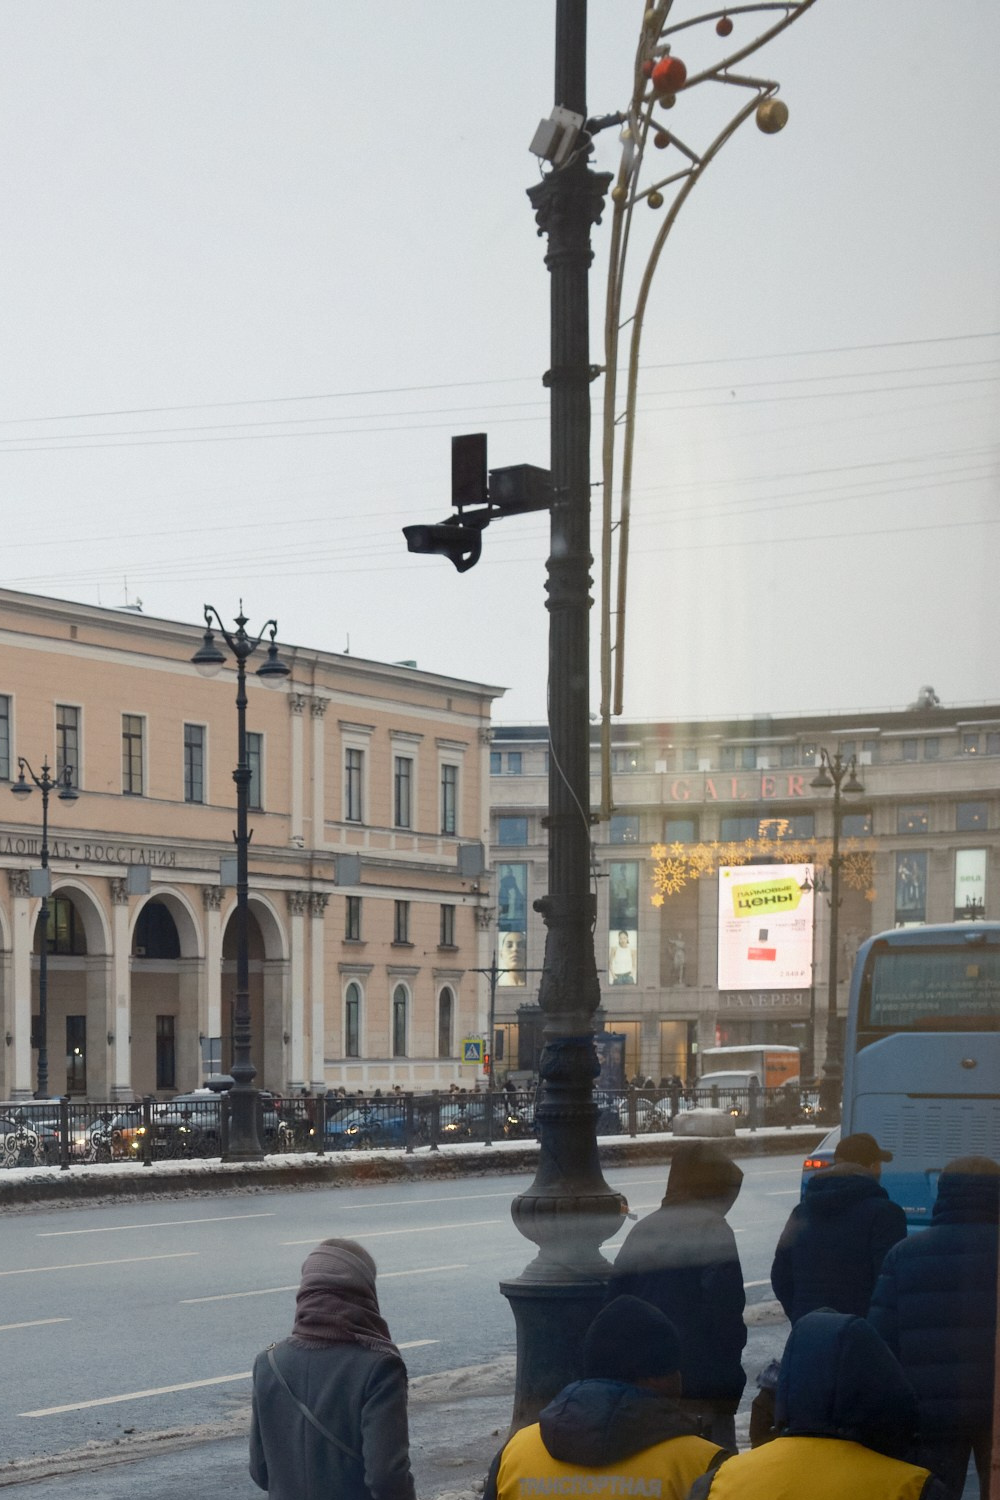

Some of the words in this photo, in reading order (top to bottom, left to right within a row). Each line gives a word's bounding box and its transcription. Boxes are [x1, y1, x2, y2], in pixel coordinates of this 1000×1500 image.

[670, 774, 806, 801] GALER
[84, 843, 177, 866] ВОССТАНИЯ
[725, 992, 803, 1007] ГАЛЕРЕЯ
[519, 1475, 663, 1498] ТРАНСПОРТНАЯ
